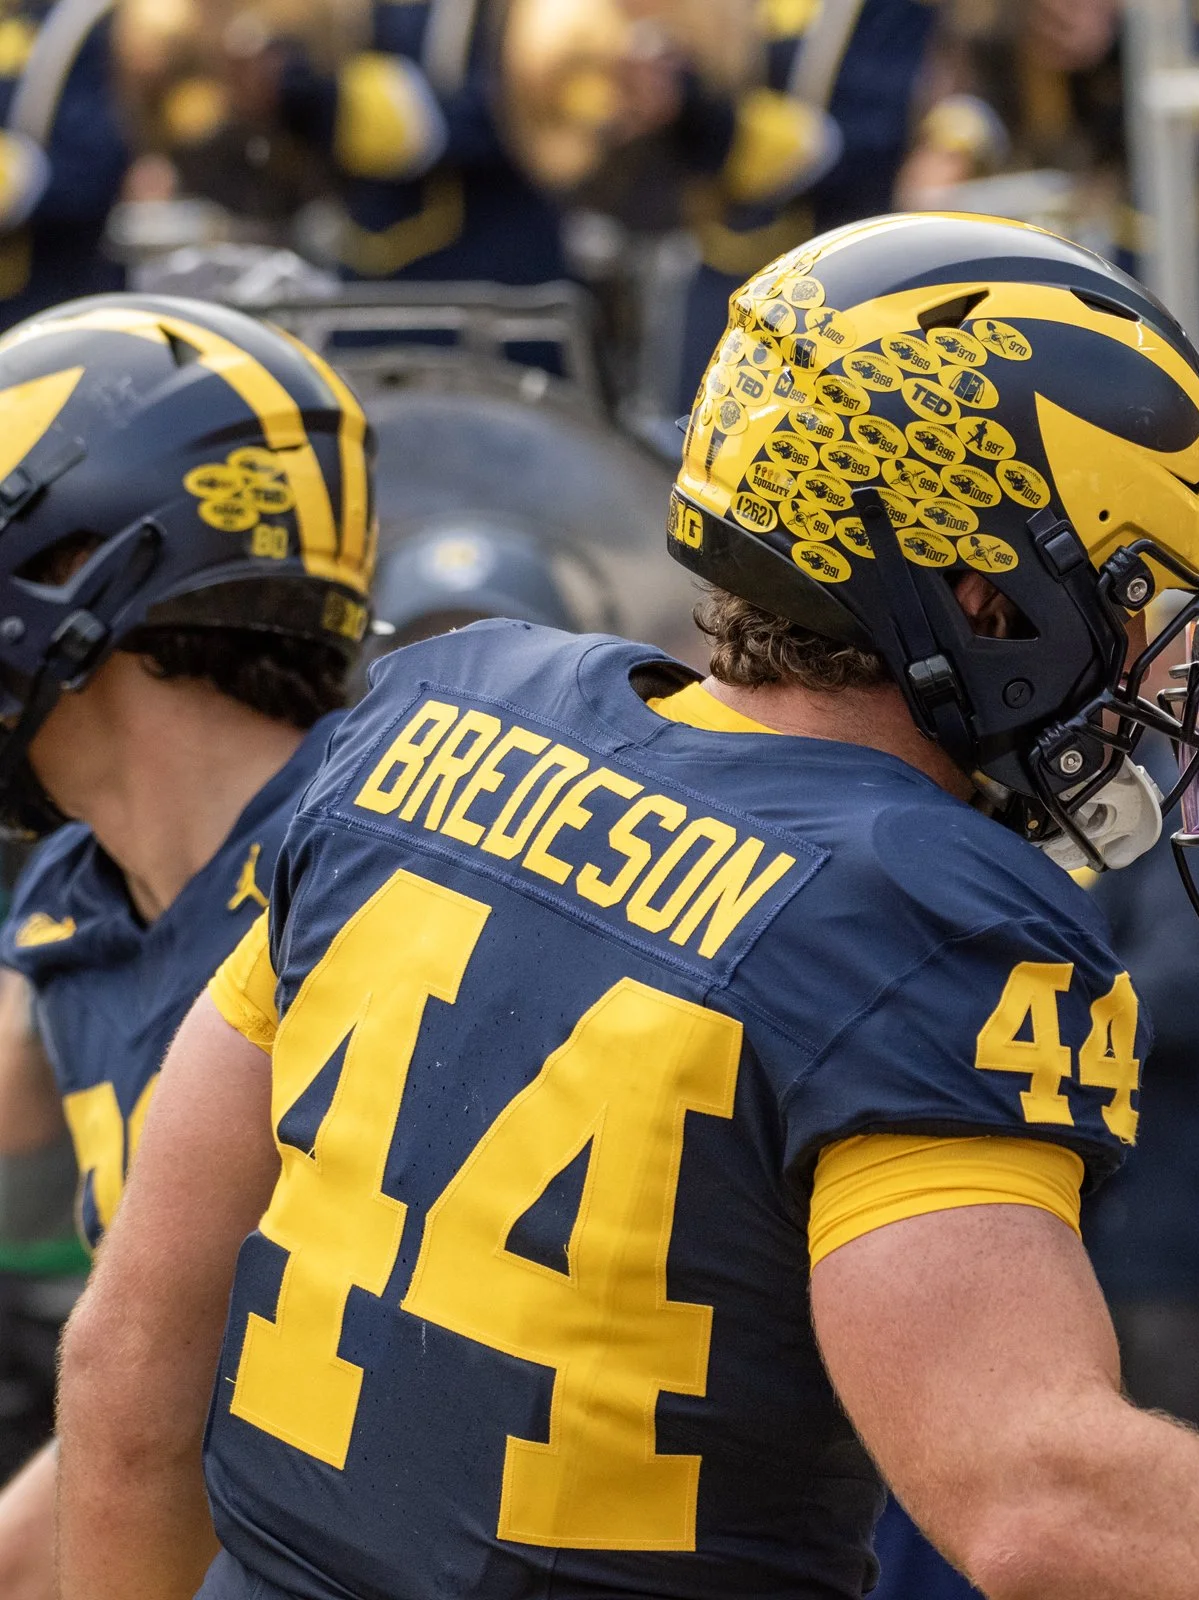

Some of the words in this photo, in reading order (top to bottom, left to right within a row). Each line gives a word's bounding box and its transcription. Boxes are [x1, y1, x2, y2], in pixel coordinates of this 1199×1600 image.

[824, 328, 845, 345] 1009
[957, 346, 977, 363] 970
[1009, 340, 1028, 357] 970
[911, 354, 931, 371] 969
[735, 371, 764, 399] TED
[873, 372, 893, 388] 968
[789, 389, 806, 405] 995
[842, 394, 861, 411] 967
[911, 382, 953, 417] TED
[816, 425, 835, 439] 966
[878, 438, 898, 456] 994
[935, 445, 956, 462] 996
[984, 440, 1005, 457] 997
[791, 451, 809, 467] 965
[850, 461, 870, 477] 993
[752, 475, 791, 498] EQUALITY
[918, 477, 938, 493] 996
[826, 491, 846, 508] 992
[970, 487, 993, 505] 1005
[1022, 486, 1041, 505] 1013
[888, 509, 907, 524] 998
[945, 517, 969, 532] 1006
[813, 520, 830, 535] 991
[925, 548, 949, 564] 1007
[994, 551, 1013, 566] 999
[823, 563, 840, 579] 991
[354, 699, 796, 959] BREDESON
[975, 961, 1140, 1146] 44
[230, 868, 744, 1552] 44
